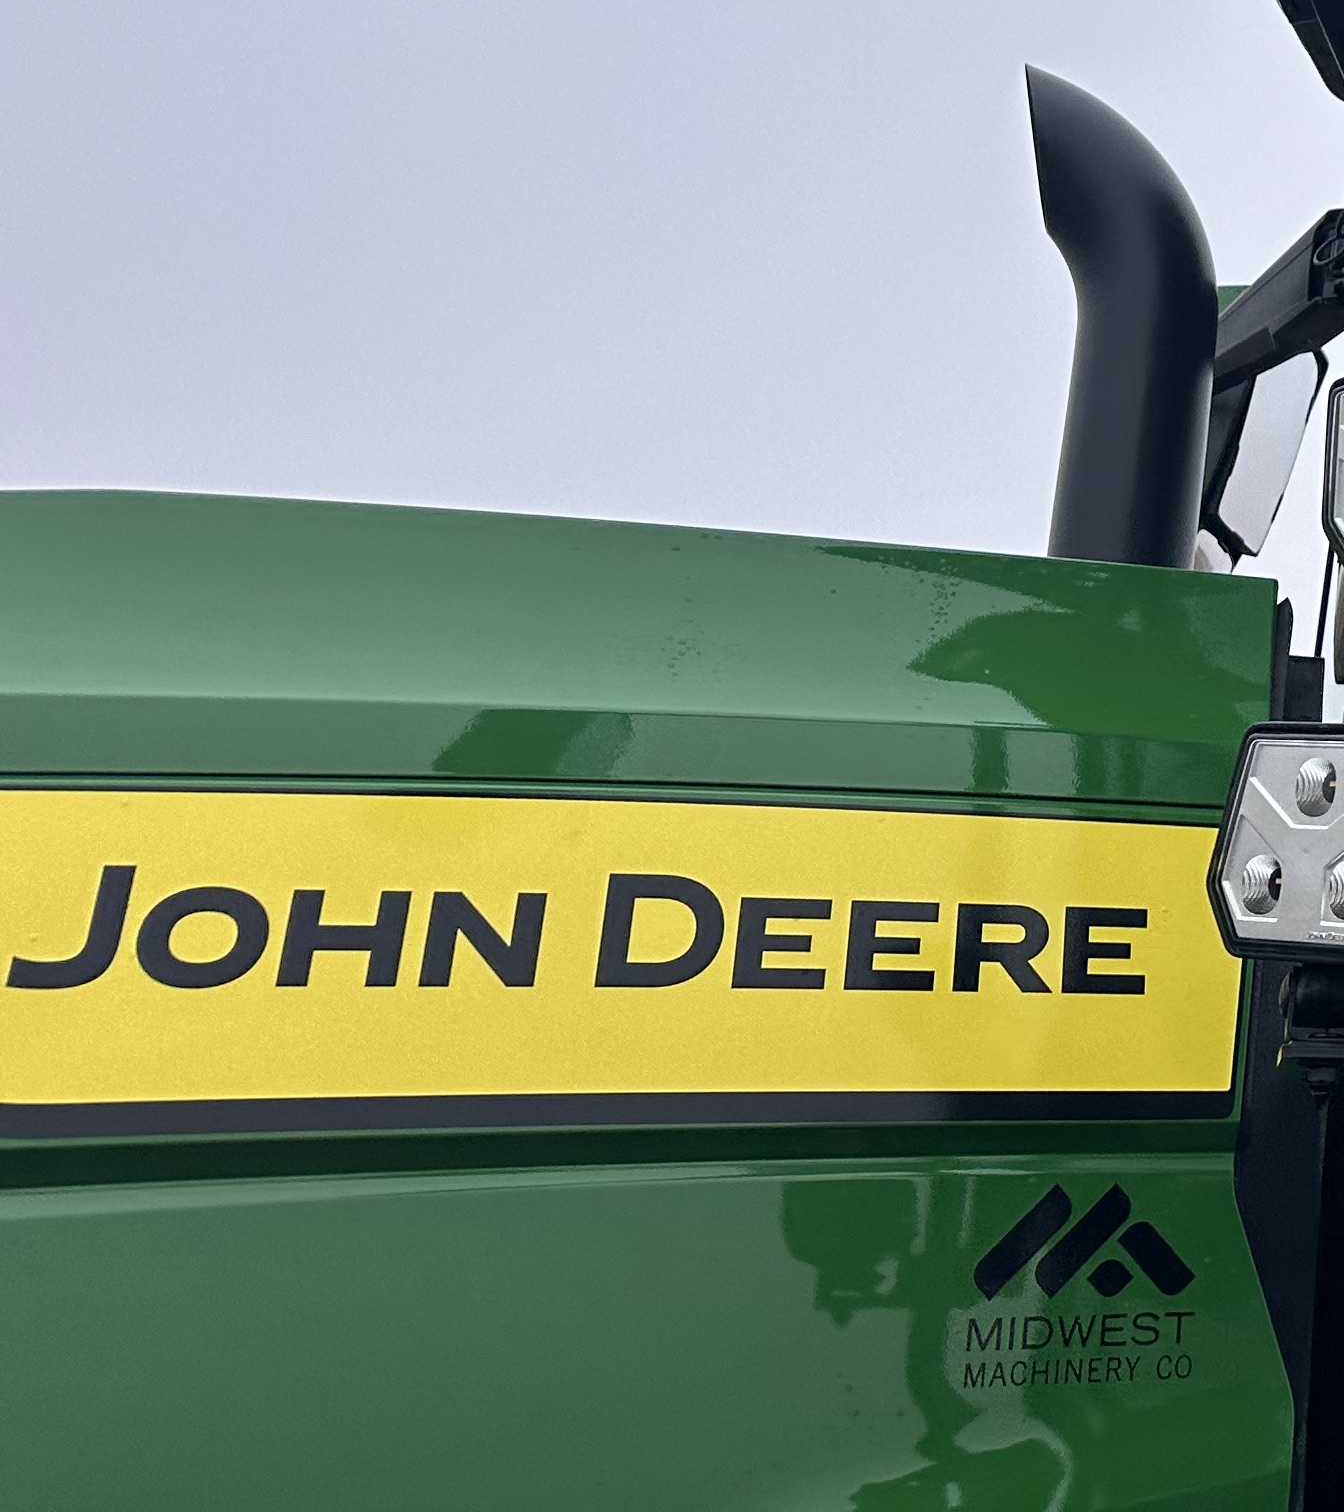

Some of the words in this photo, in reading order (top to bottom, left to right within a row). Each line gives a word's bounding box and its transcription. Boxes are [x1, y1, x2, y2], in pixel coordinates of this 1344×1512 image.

[5, 865, 548, 990] JOHN
[594, 873, 1149, 996] DEERE
[965, 1311, 1196, 1352] MIDWEST
[962, 1355, 1141, 1389] MACHINERY
[1155, 1353, 1193, 1380] CO
